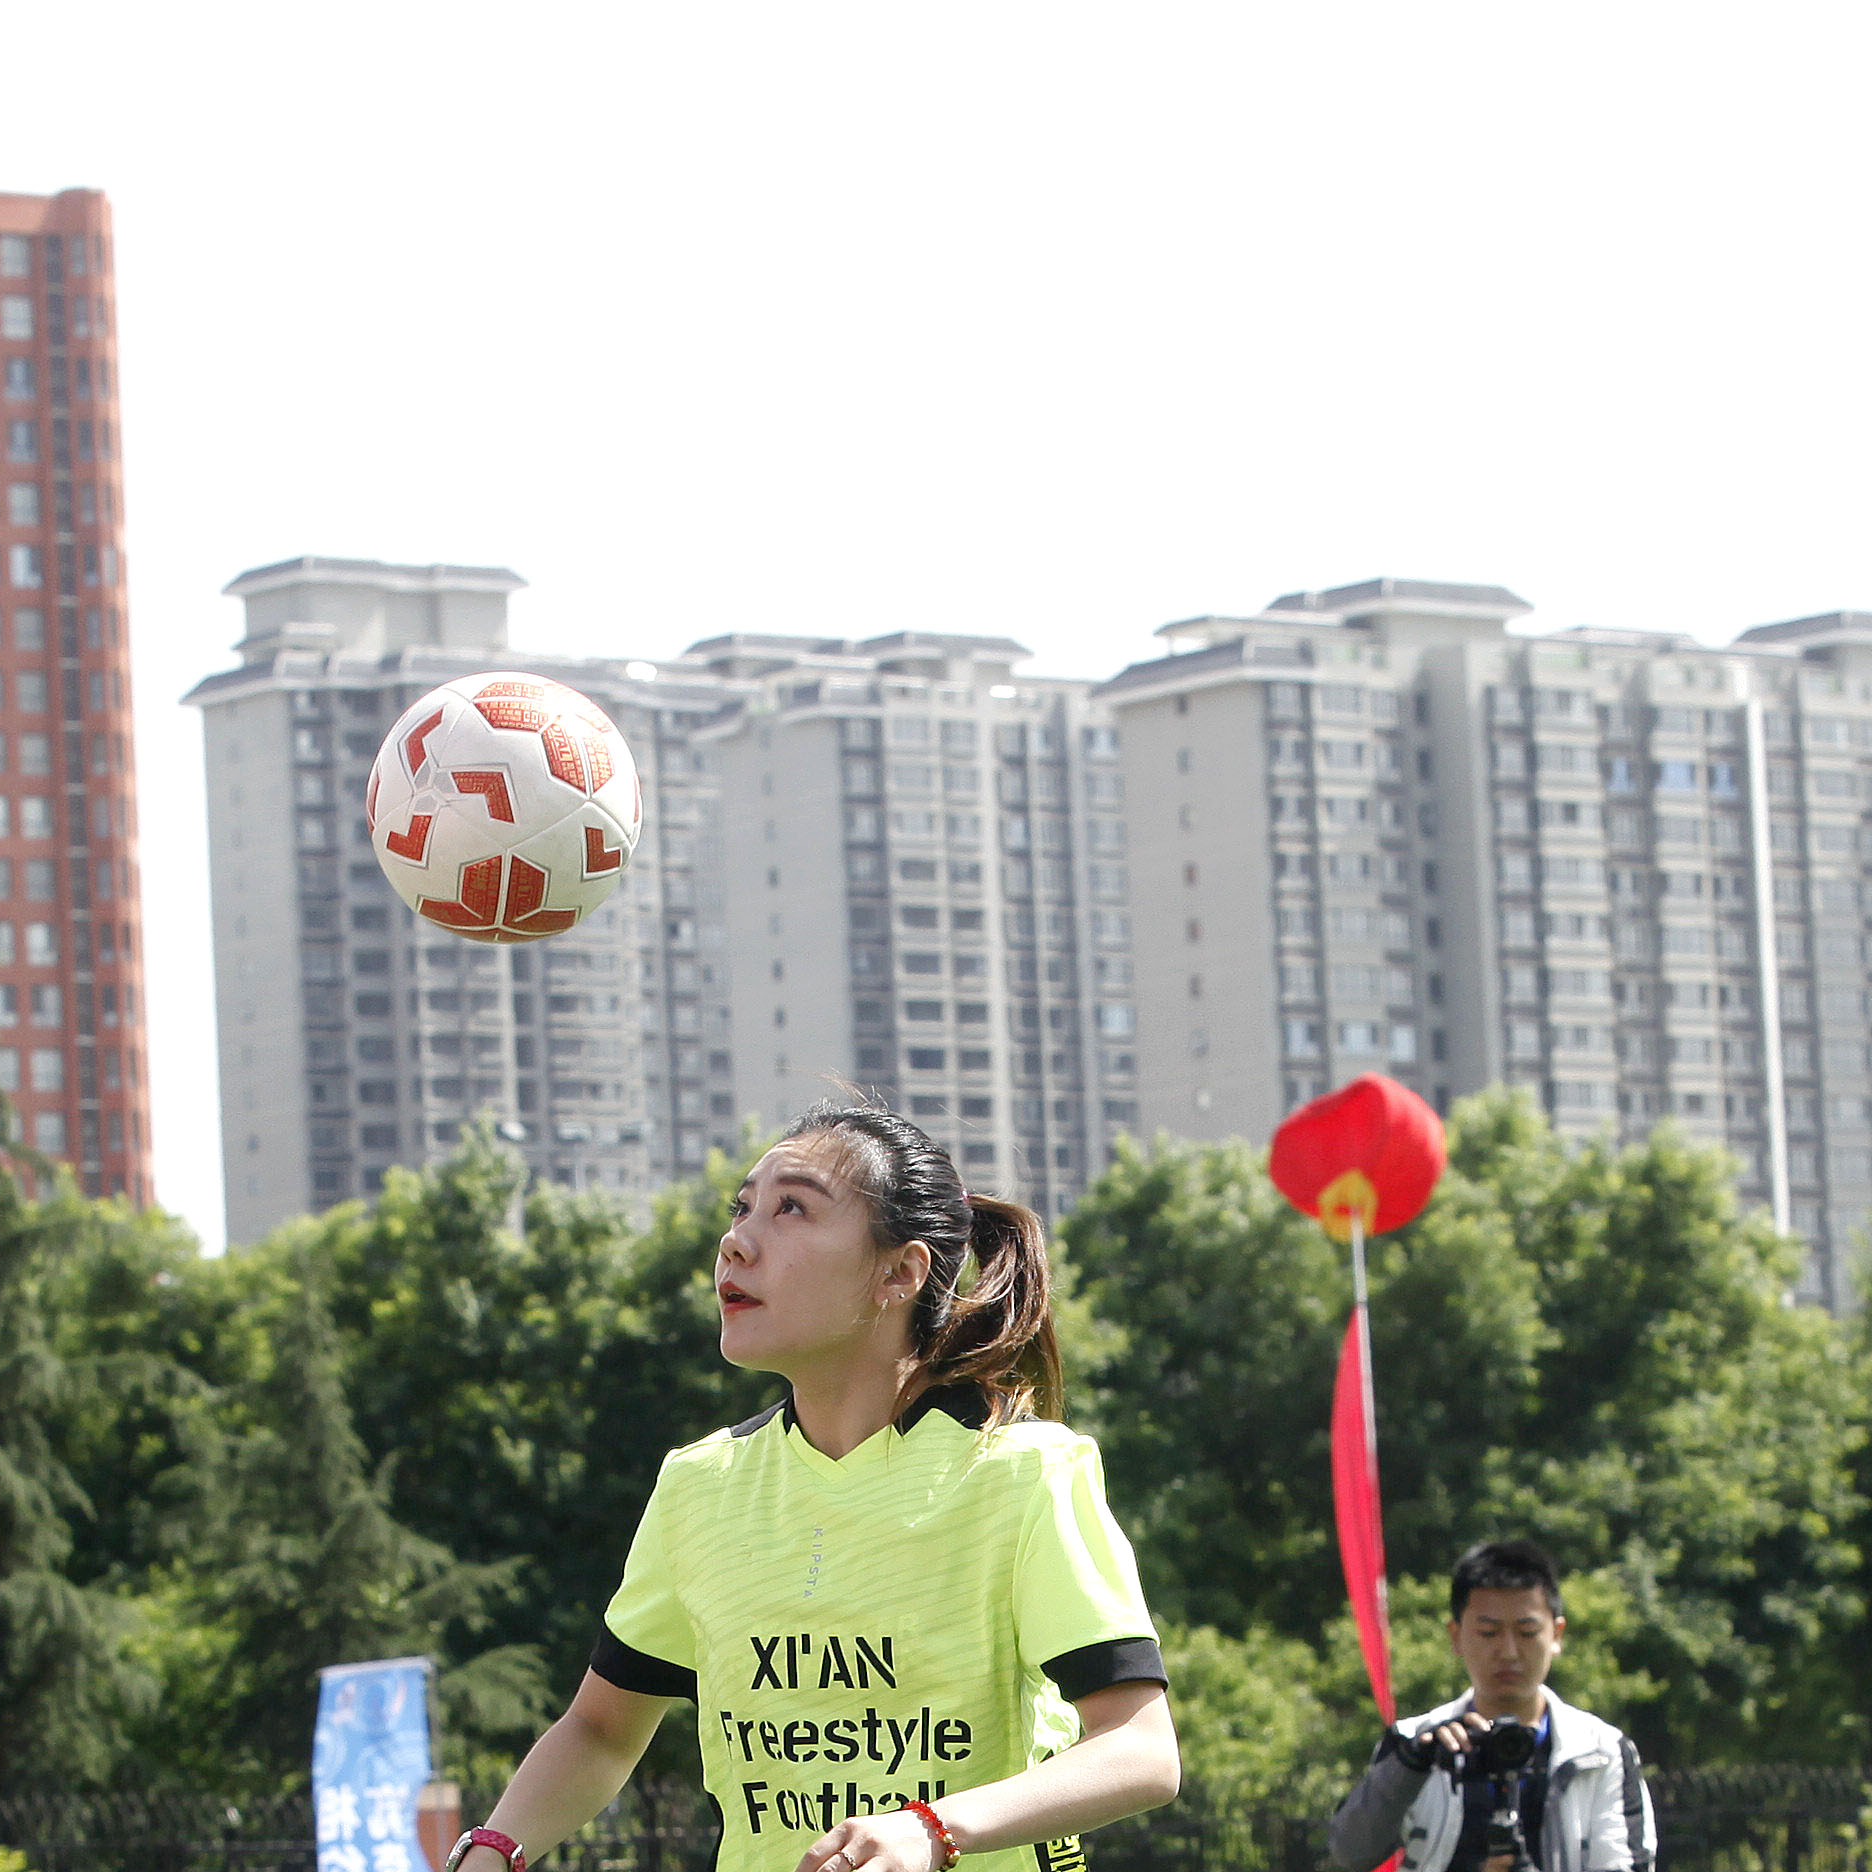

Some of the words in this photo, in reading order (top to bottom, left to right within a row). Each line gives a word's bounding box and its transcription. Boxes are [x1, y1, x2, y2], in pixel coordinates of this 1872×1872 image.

[803, 1528, 824, 1598] KIPSTA
[750, 1634, 896, 1690] XI'AN
[720, 1706, 972, 1775] Freestyle
